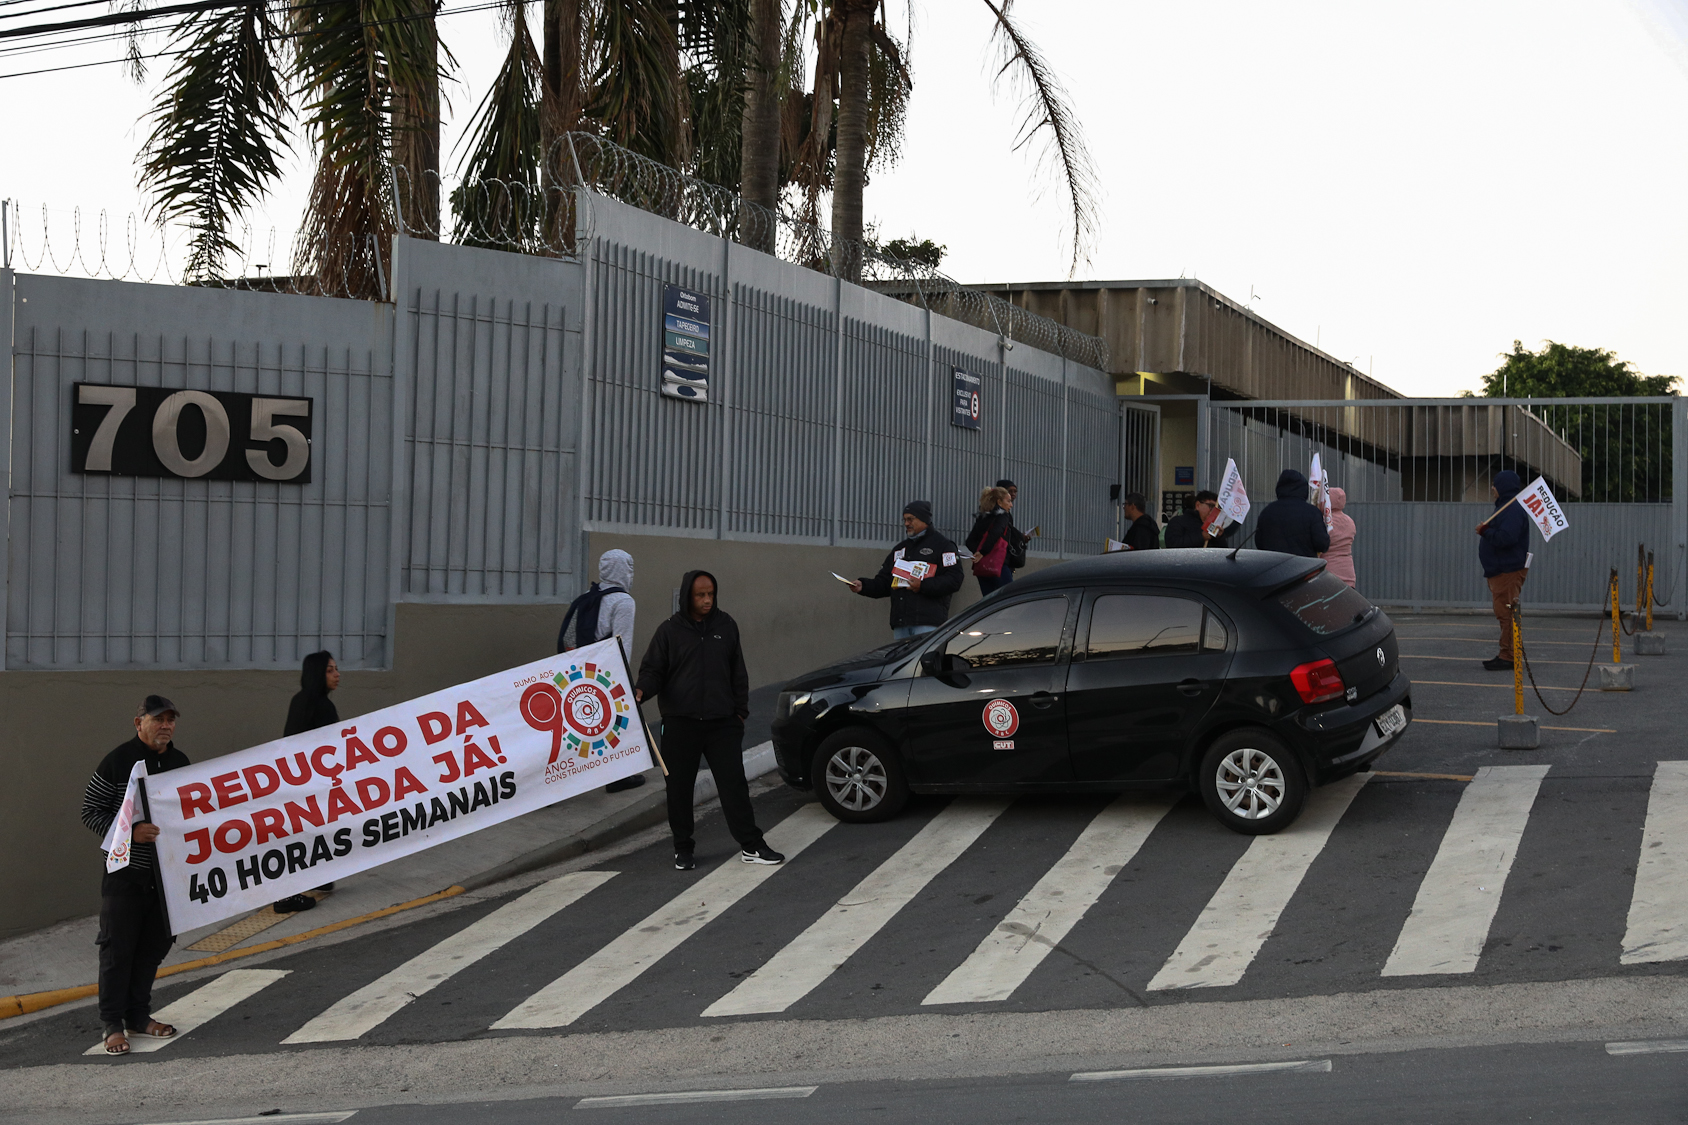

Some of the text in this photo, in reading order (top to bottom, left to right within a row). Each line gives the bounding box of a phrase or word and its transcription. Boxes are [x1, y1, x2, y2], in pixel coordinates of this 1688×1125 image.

[675, 337, 696, 349] LIMPEZA
[676, 320, 699, 333] TAPECEIRO
[78, 384, 310, 481] 705
[1522, 493, 1545, 518] JÁ!
[1537, 485, 1564, 527] REDUÇÃO
[513, 669, 555, 689] RUMO AOS
[176, 725, 408, 821] REDUÇÃO
[416, 699, 490, 746] DA
[544, 745, 641, 785] CONSTRUINDO O FUTURO
[544, 757, 575, 777] ANOS
[183, 765, 429, 865] JORNADA
[431, 734, 508, 784] JÁ!
[189, 770, 517, 905] 40 HORAS SEMANAIS
